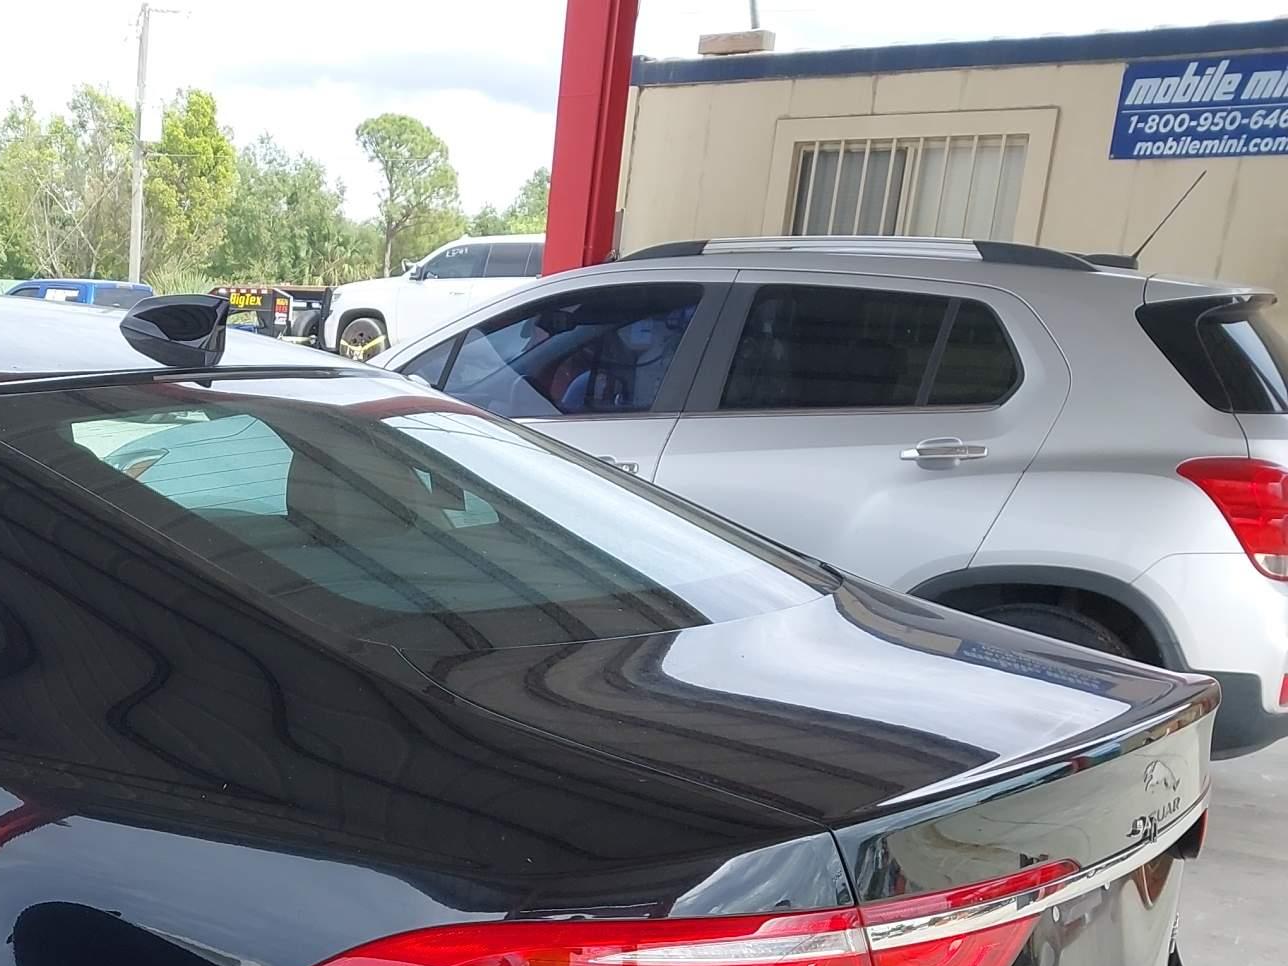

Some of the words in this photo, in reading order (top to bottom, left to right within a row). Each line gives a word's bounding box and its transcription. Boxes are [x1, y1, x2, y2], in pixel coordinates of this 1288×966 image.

[1125, 59, 1242, 105] mobile
[1133, 134, 1288, 156] mobilemini.com
[230, 293, 263, 308] BigTex
